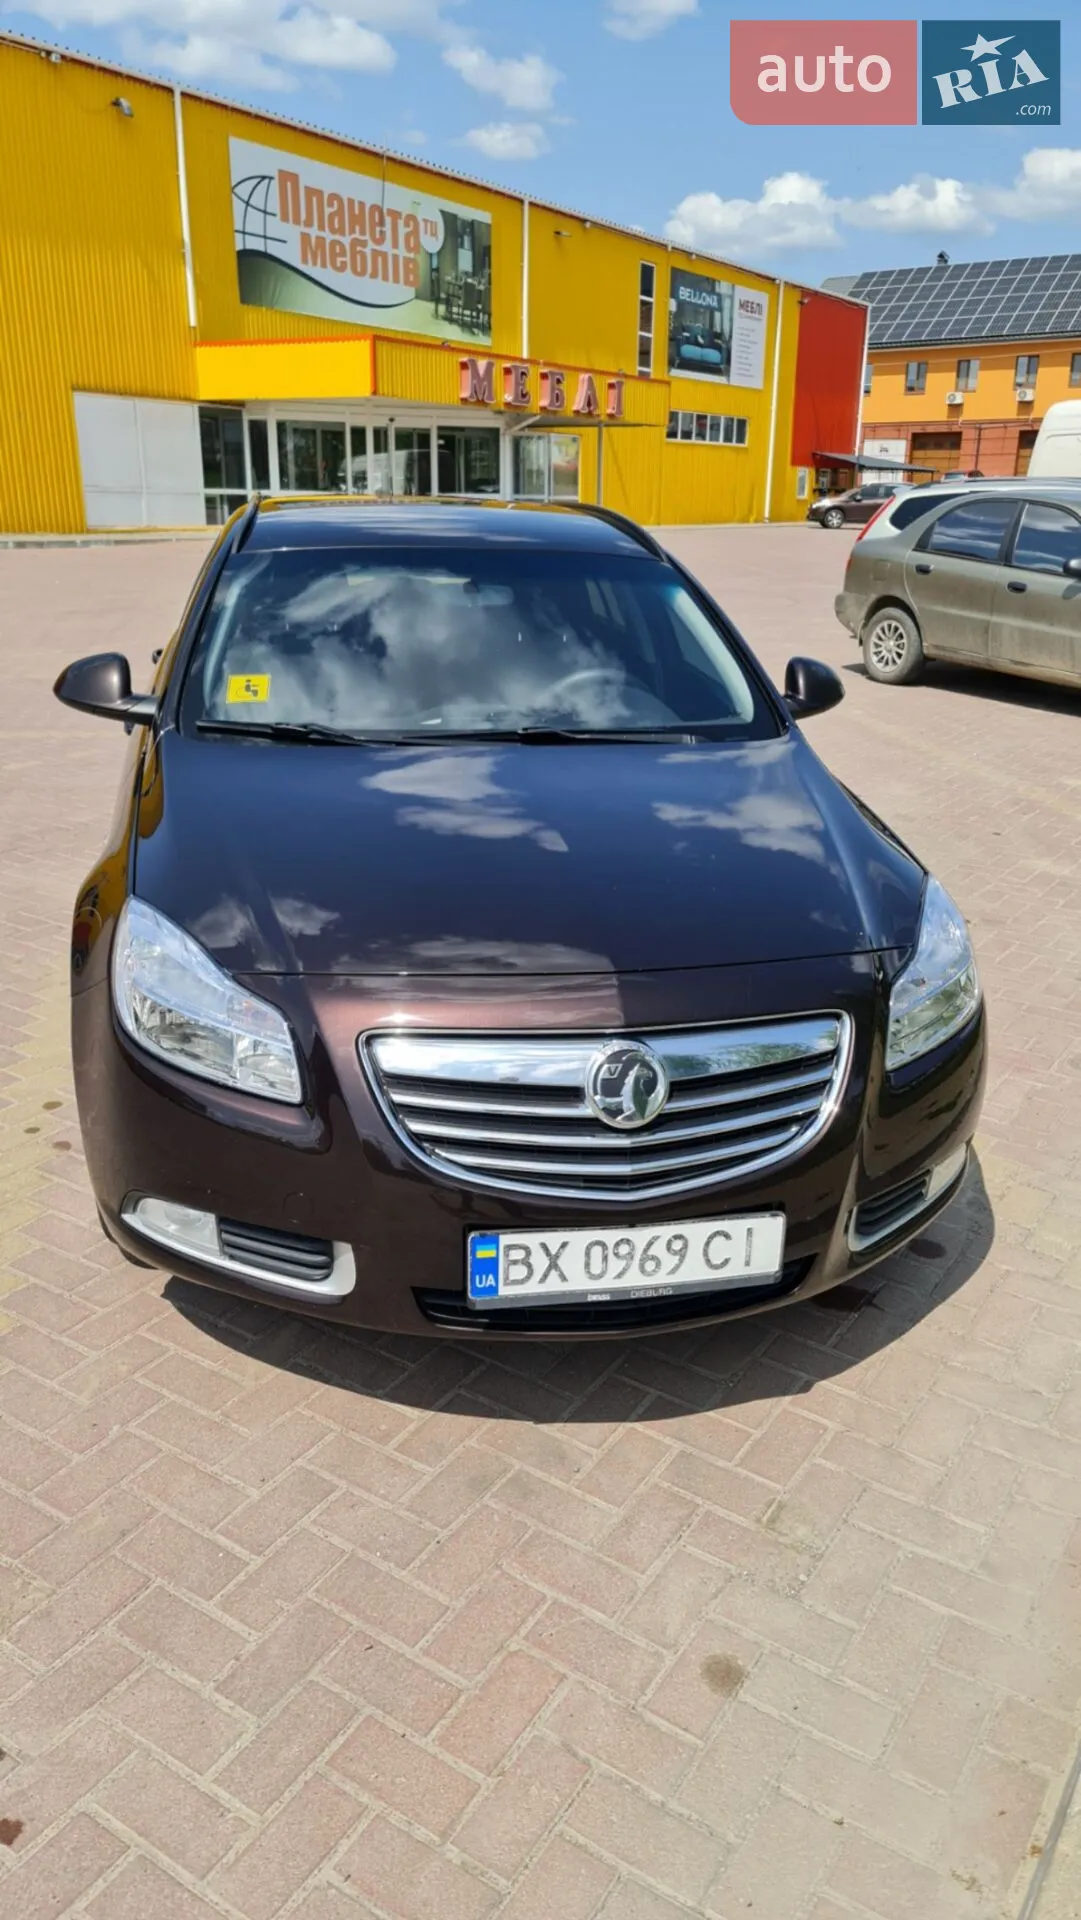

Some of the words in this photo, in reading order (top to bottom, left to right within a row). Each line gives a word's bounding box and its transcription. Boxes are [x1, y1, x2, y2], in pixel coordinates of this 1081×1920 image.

[277, 169, 421, 255] Планета
[299, 231, 420, 289] меблів
[679, 286, 718, 308] BELLONA
[738, 298, 763, 315] МЕБЛІ
[459, 358, 624, 418] МЕБЛІ
[475, 1275, 495, 1288] UA
[502, 1240, 570, 1287] BX
[584, 1233, 689, 1281] 0969
